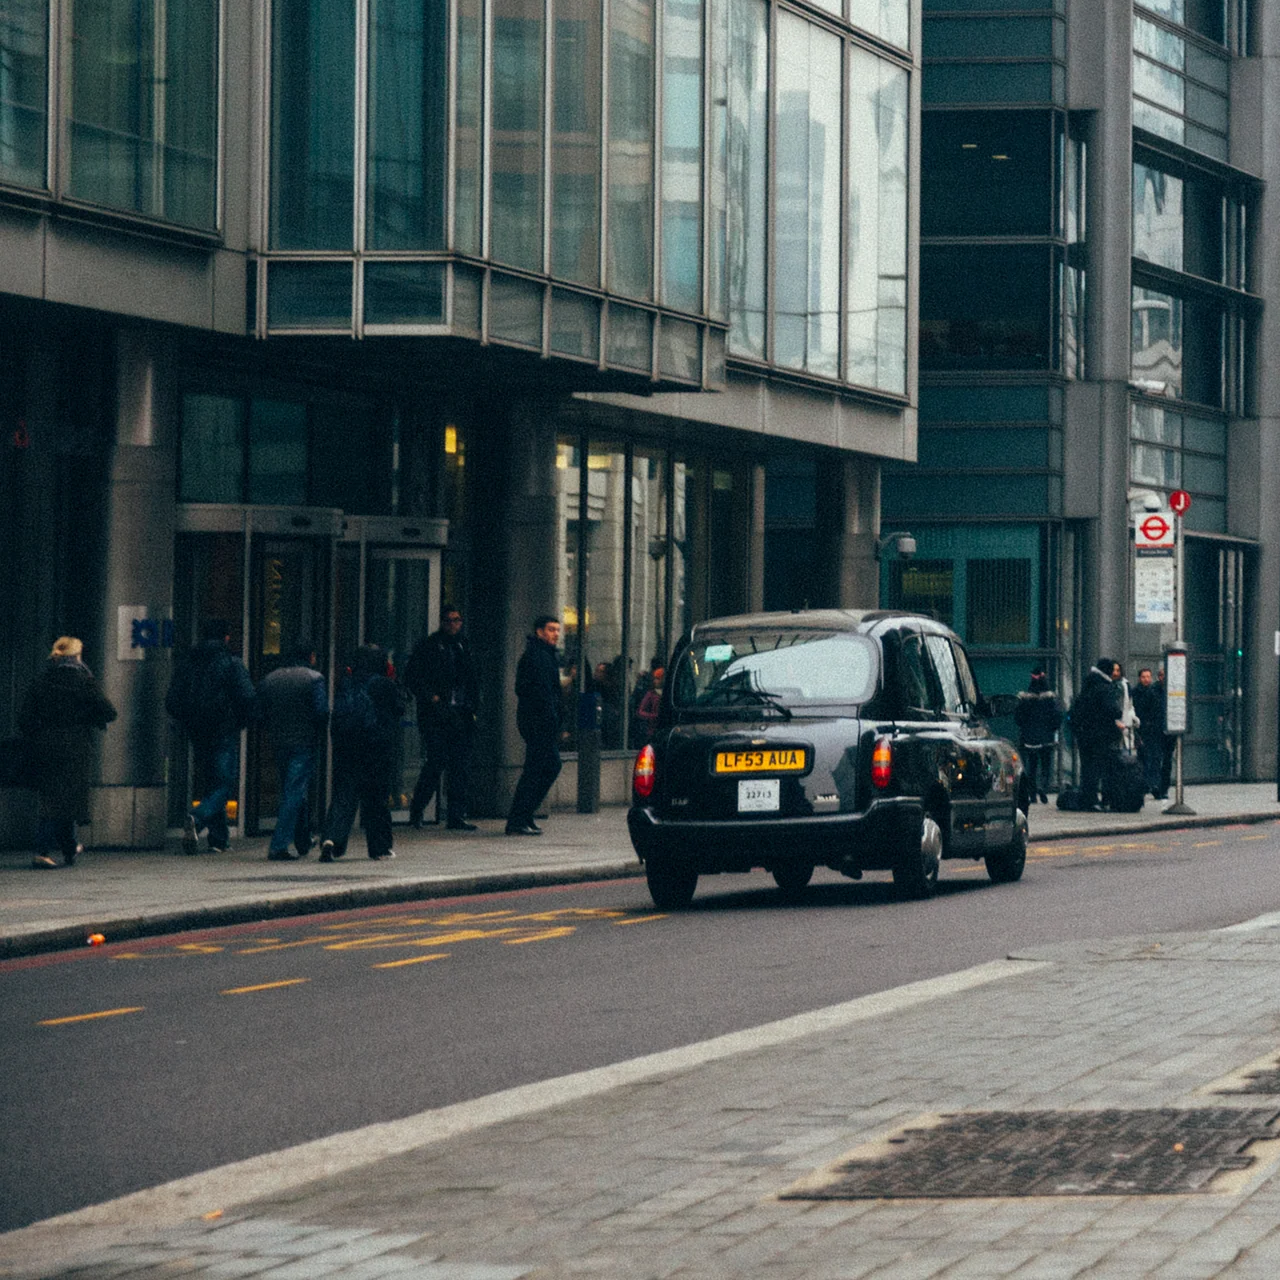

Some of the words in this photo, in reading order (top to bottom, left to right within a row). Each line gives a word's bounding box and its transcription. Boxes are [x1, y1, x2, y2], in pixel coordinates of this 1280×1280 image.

[1175, 493, 1185, 510] J
[723, 752, 764, 768] LF53
[768, 751, 798, 766] AUA
